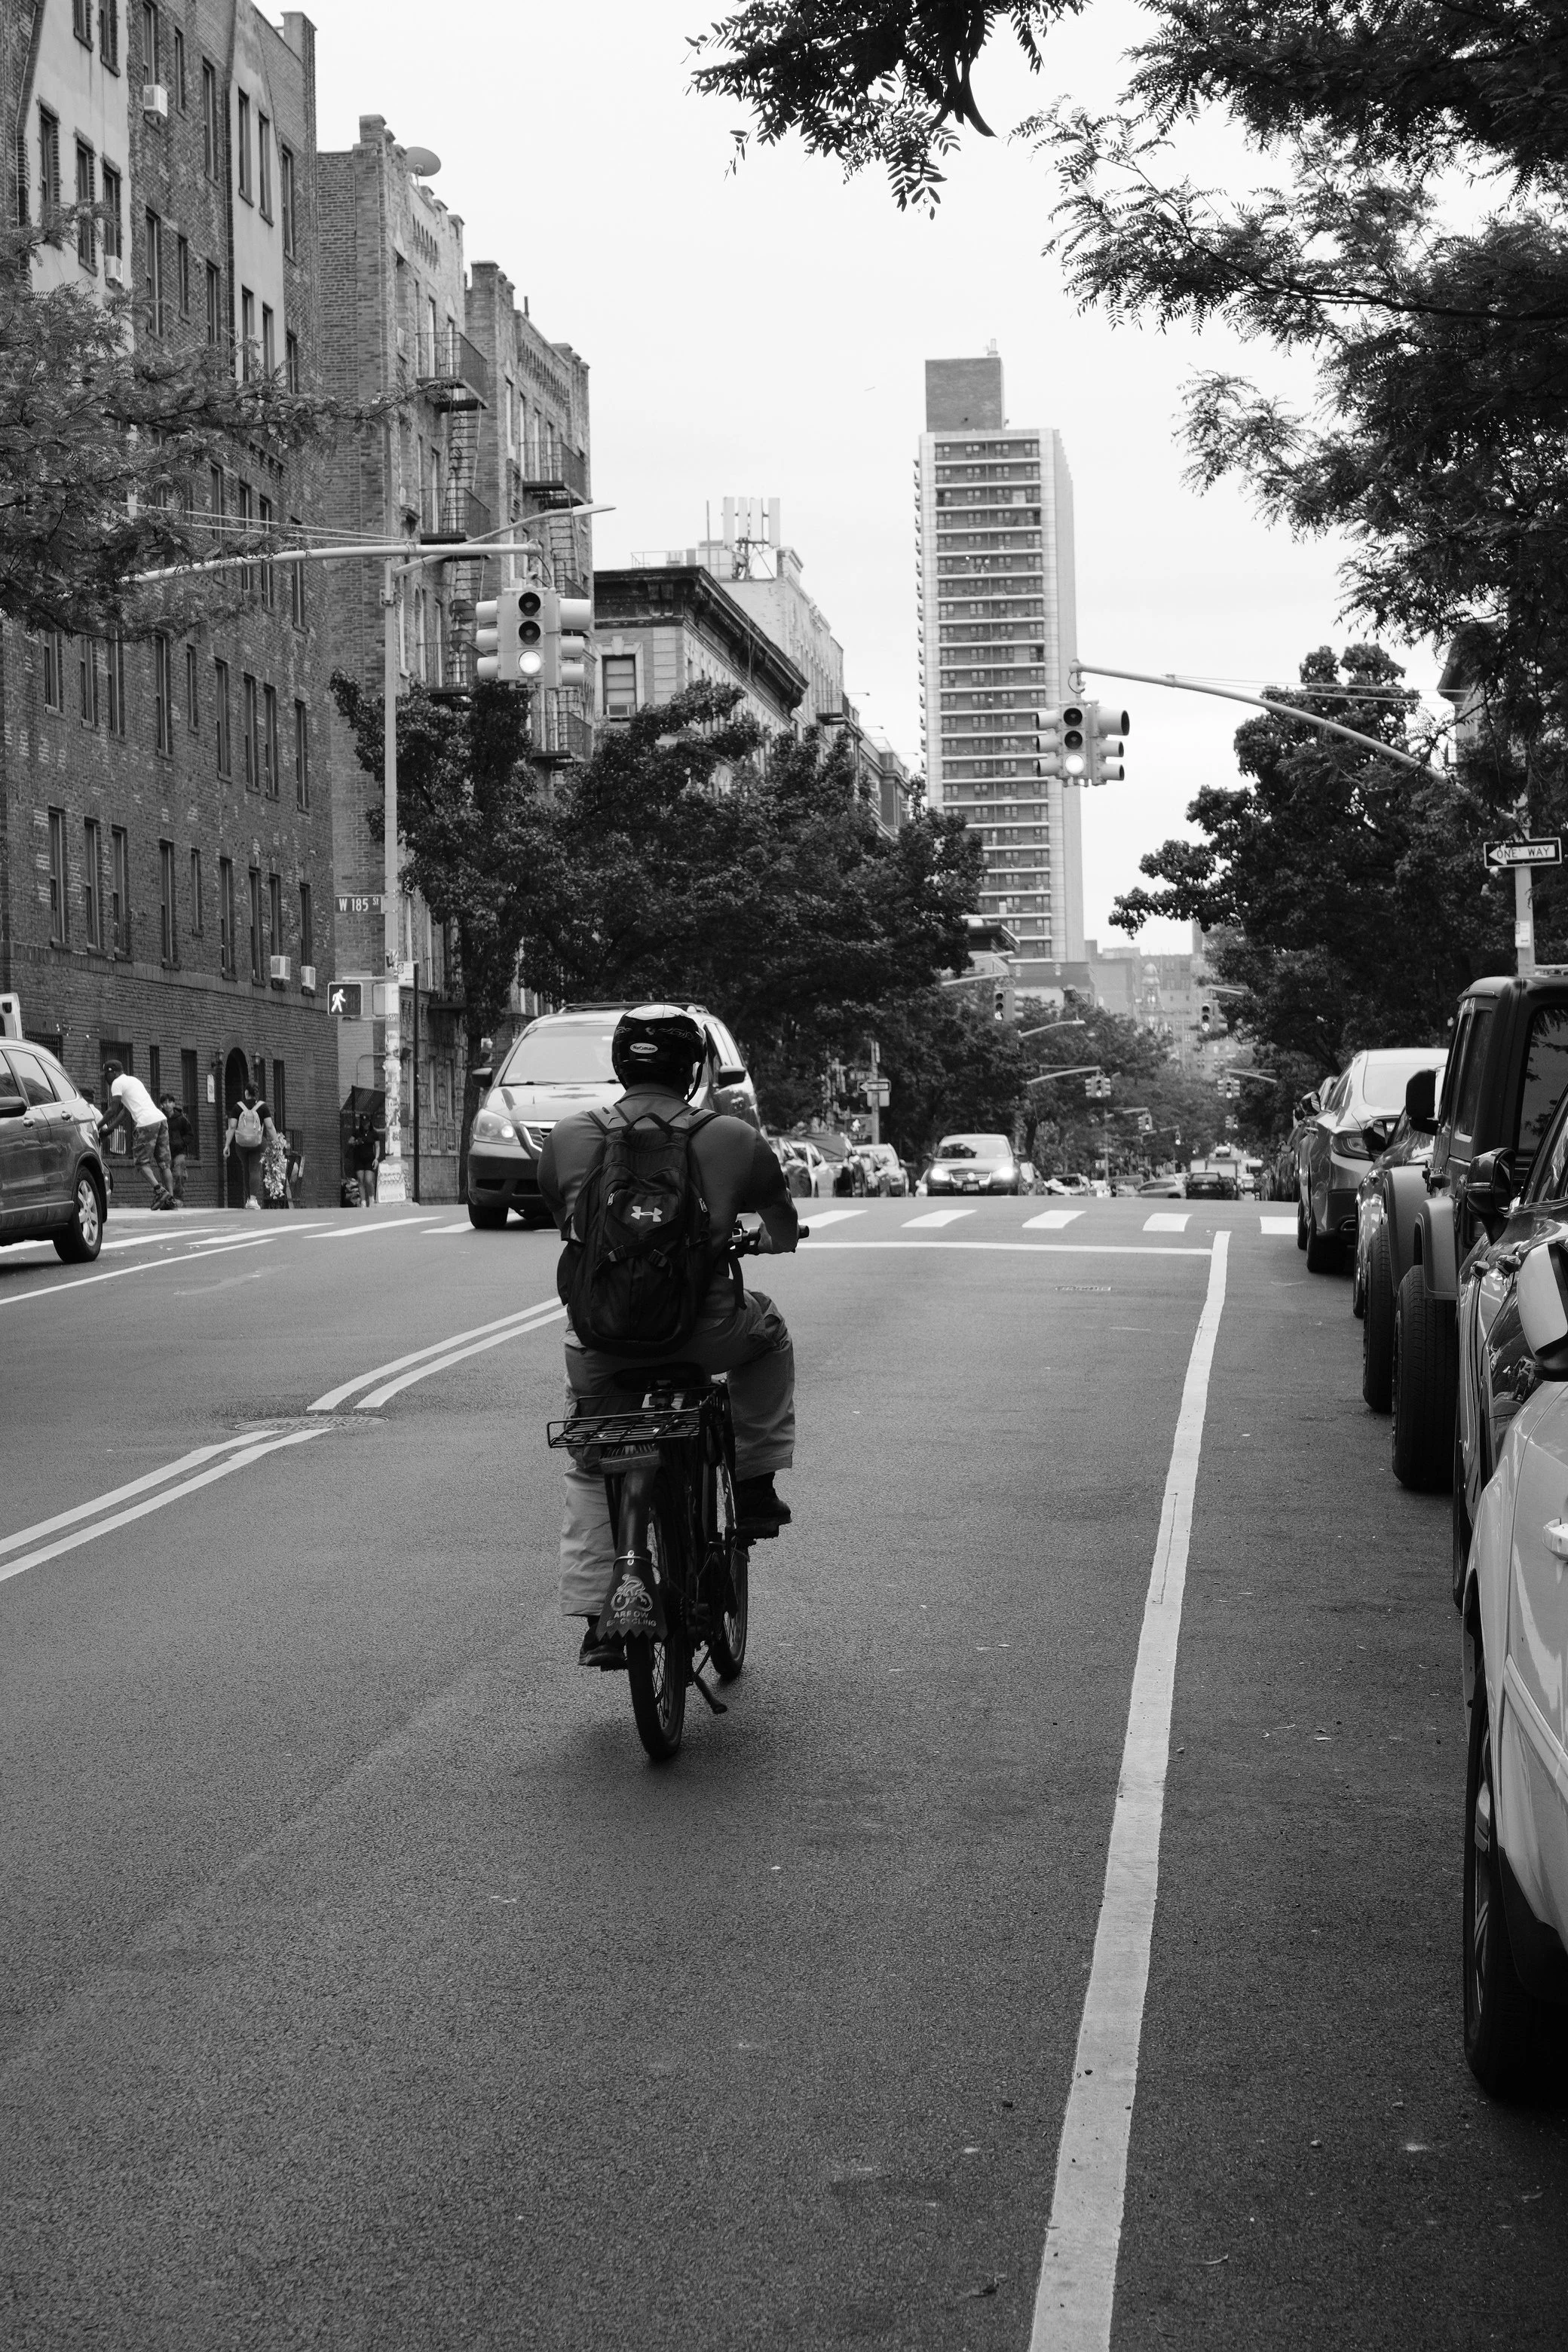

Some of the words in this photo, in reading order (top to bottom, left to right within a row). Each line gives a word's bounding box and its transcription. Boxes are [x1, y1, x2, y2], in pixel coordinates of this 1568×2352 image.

[1496, 848, 1517, 859] ONE
[1527, 847, 1550, 856] WAY
[338, 897, 348, 912] W
[351, 897, 369, 912] 185
[372, 897, 379, 905] St
